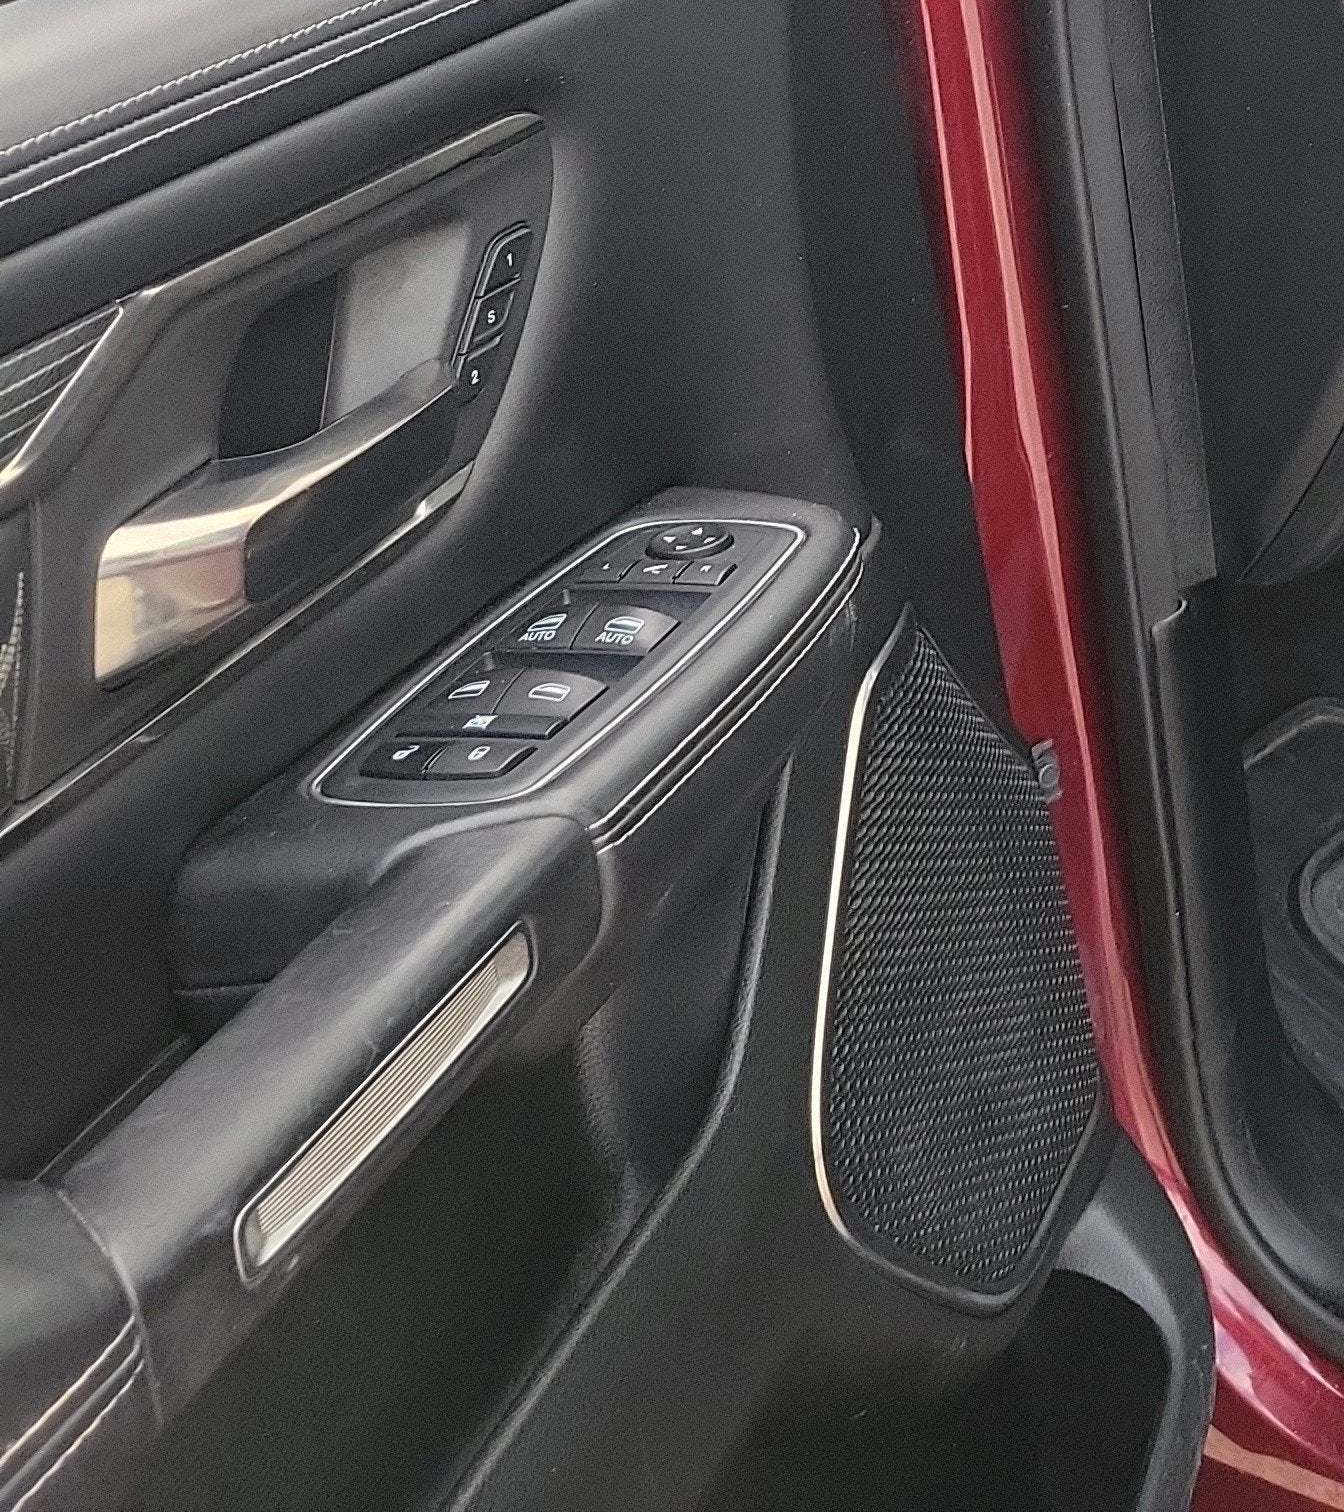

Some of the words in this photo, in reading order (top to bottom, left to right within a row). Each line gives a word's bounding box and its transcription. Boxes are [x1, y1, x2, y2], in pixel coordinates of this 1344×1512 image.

[506, 253, 514, 267] 1
[487, 309, 496, 324] S
[470, 369, 480, 385] 2
[517, 630, 556, 642] AUTO
[594, 632, 635, 645] AUTO
